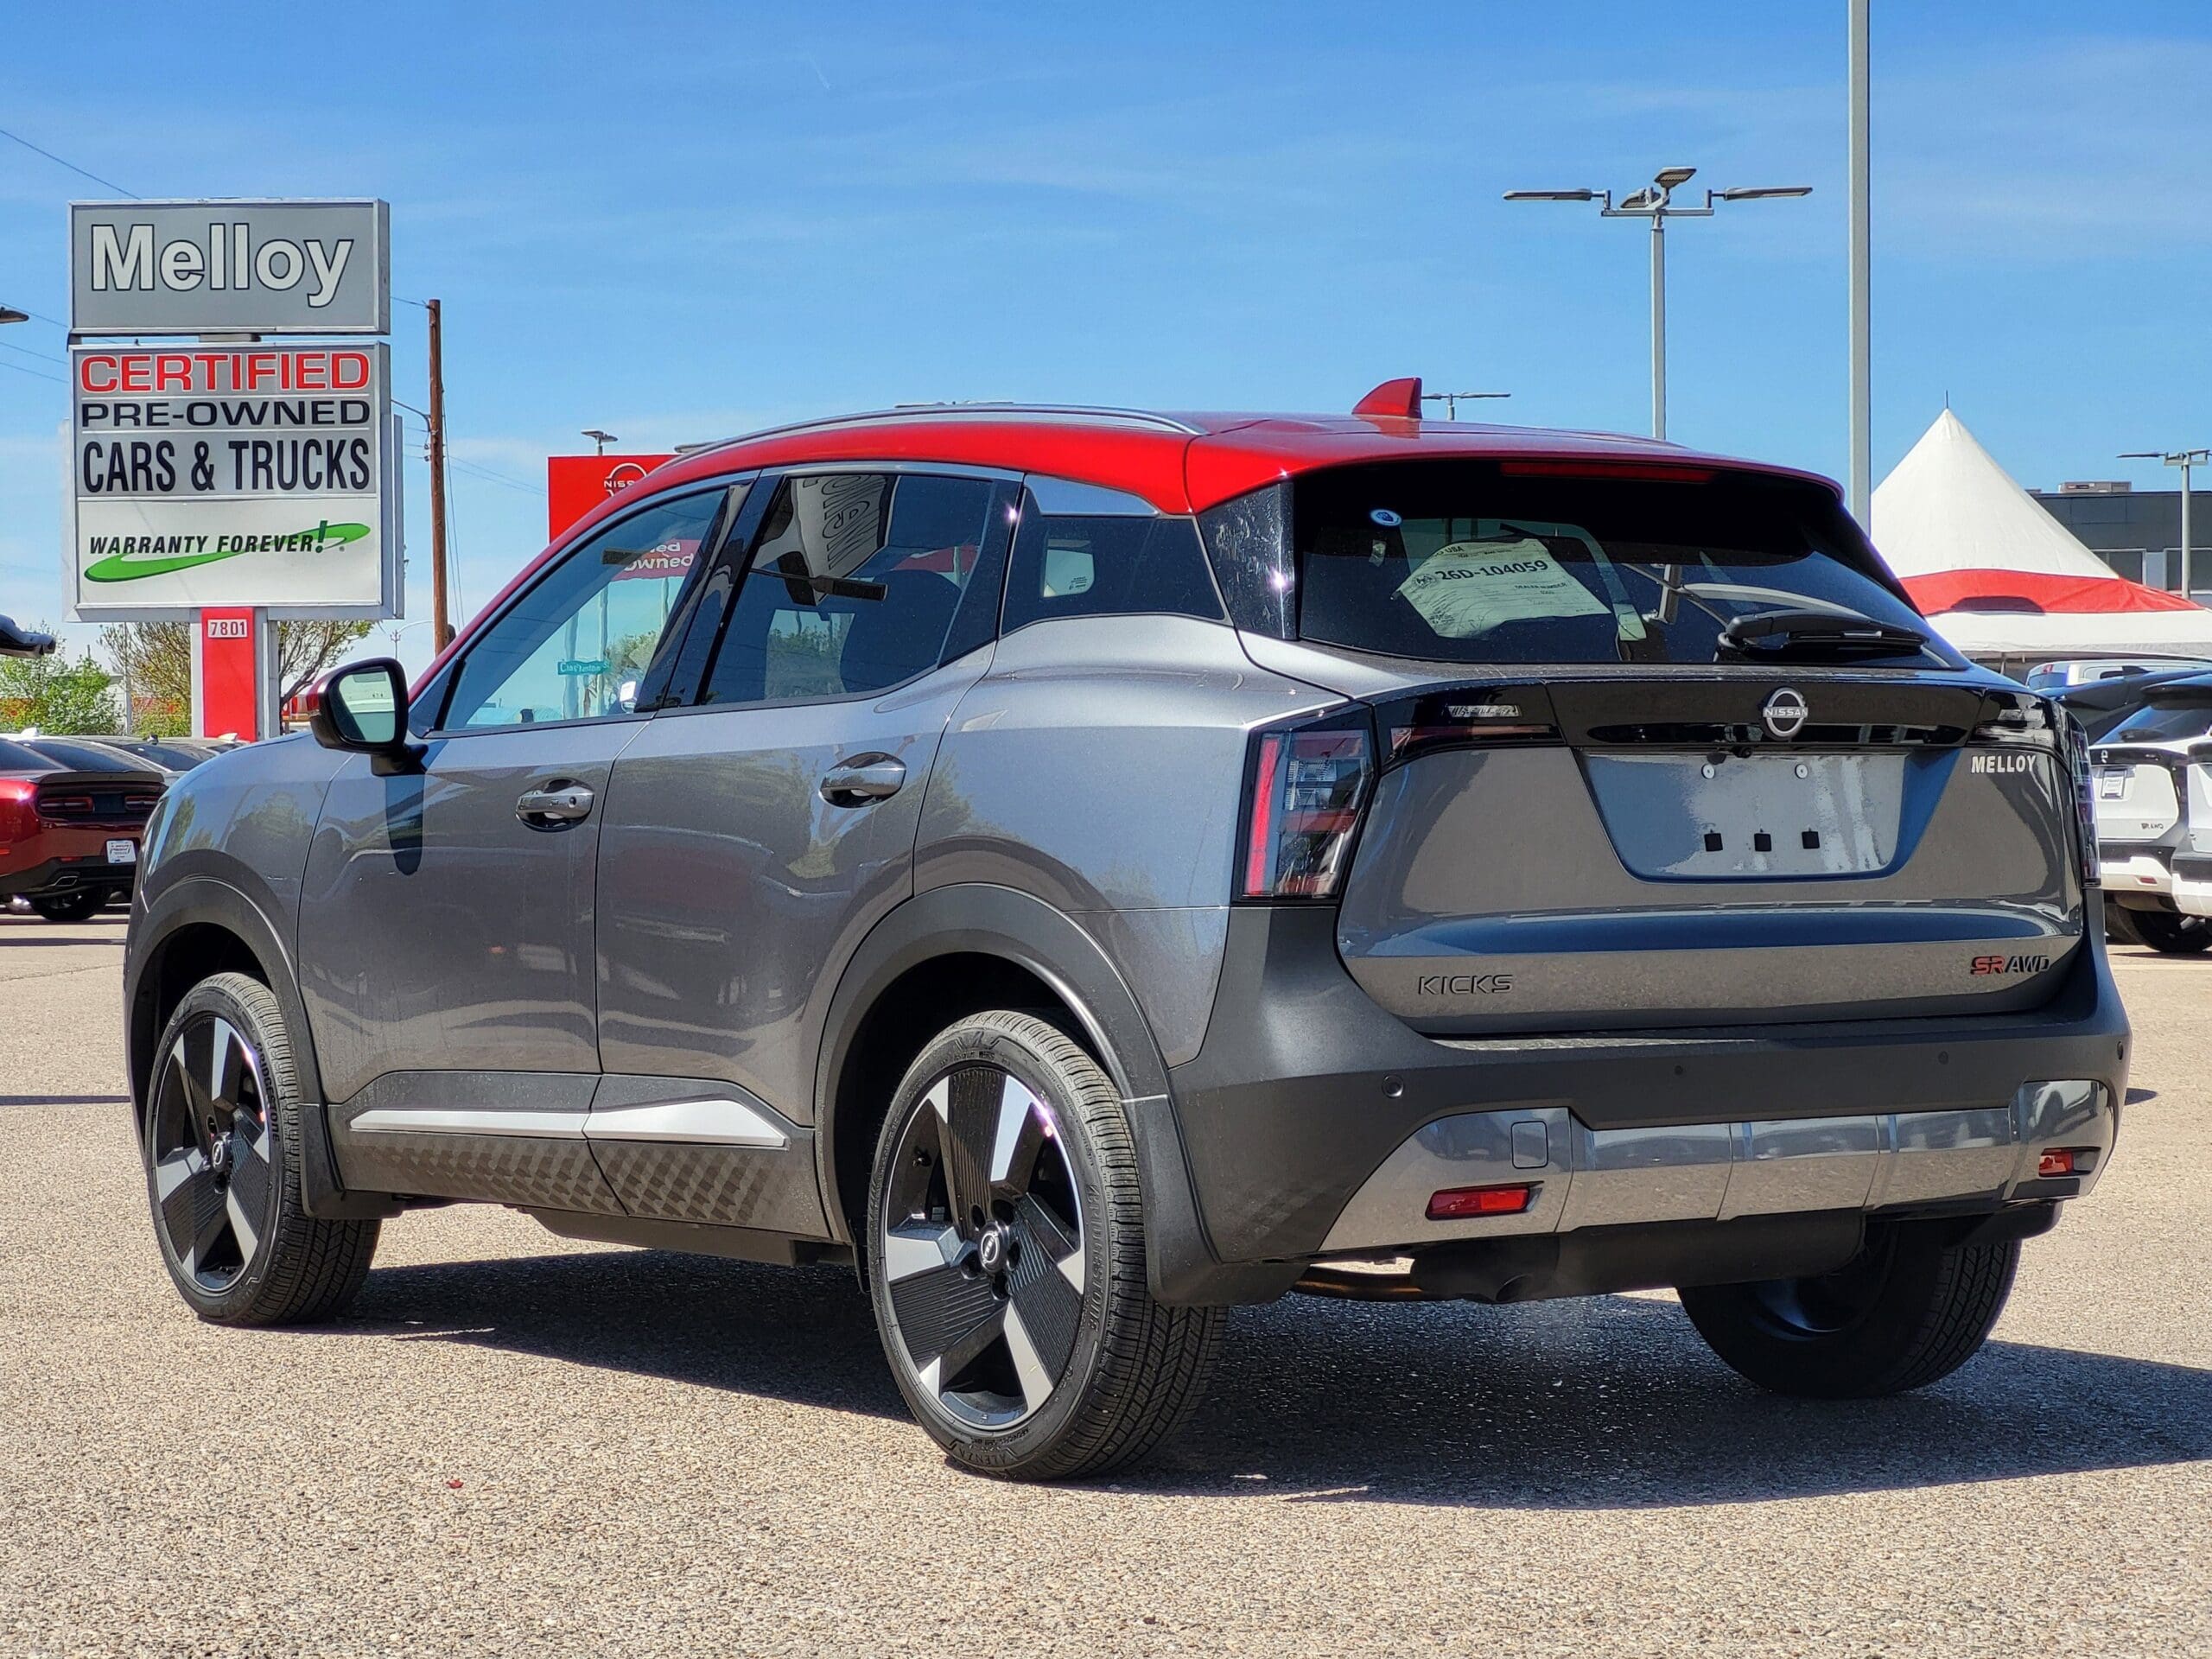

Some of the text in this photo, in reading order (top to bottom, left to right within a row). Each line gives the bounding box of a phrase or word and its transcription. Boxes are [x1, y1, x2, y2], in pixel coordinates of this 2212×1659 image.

[91, 222, 354, 308] Melloy
[80, 352, 371, 393] CERTIFIED
[81, 400, 371, 427] PRE-OWNED
[83, 438, 370, 493] CARS & TRUCKS
[89, 520, 328, 555] WARRANTY FOREVER!
[1434, 559, 1549, 582] 26D-104059
[210, 622, 246, 636] 7801
[1764, 708, 1808, 717] NISSAN
[1971, 755, 2036, 773] MELLOY
[1418, 974, 1513, 995] KICKS
